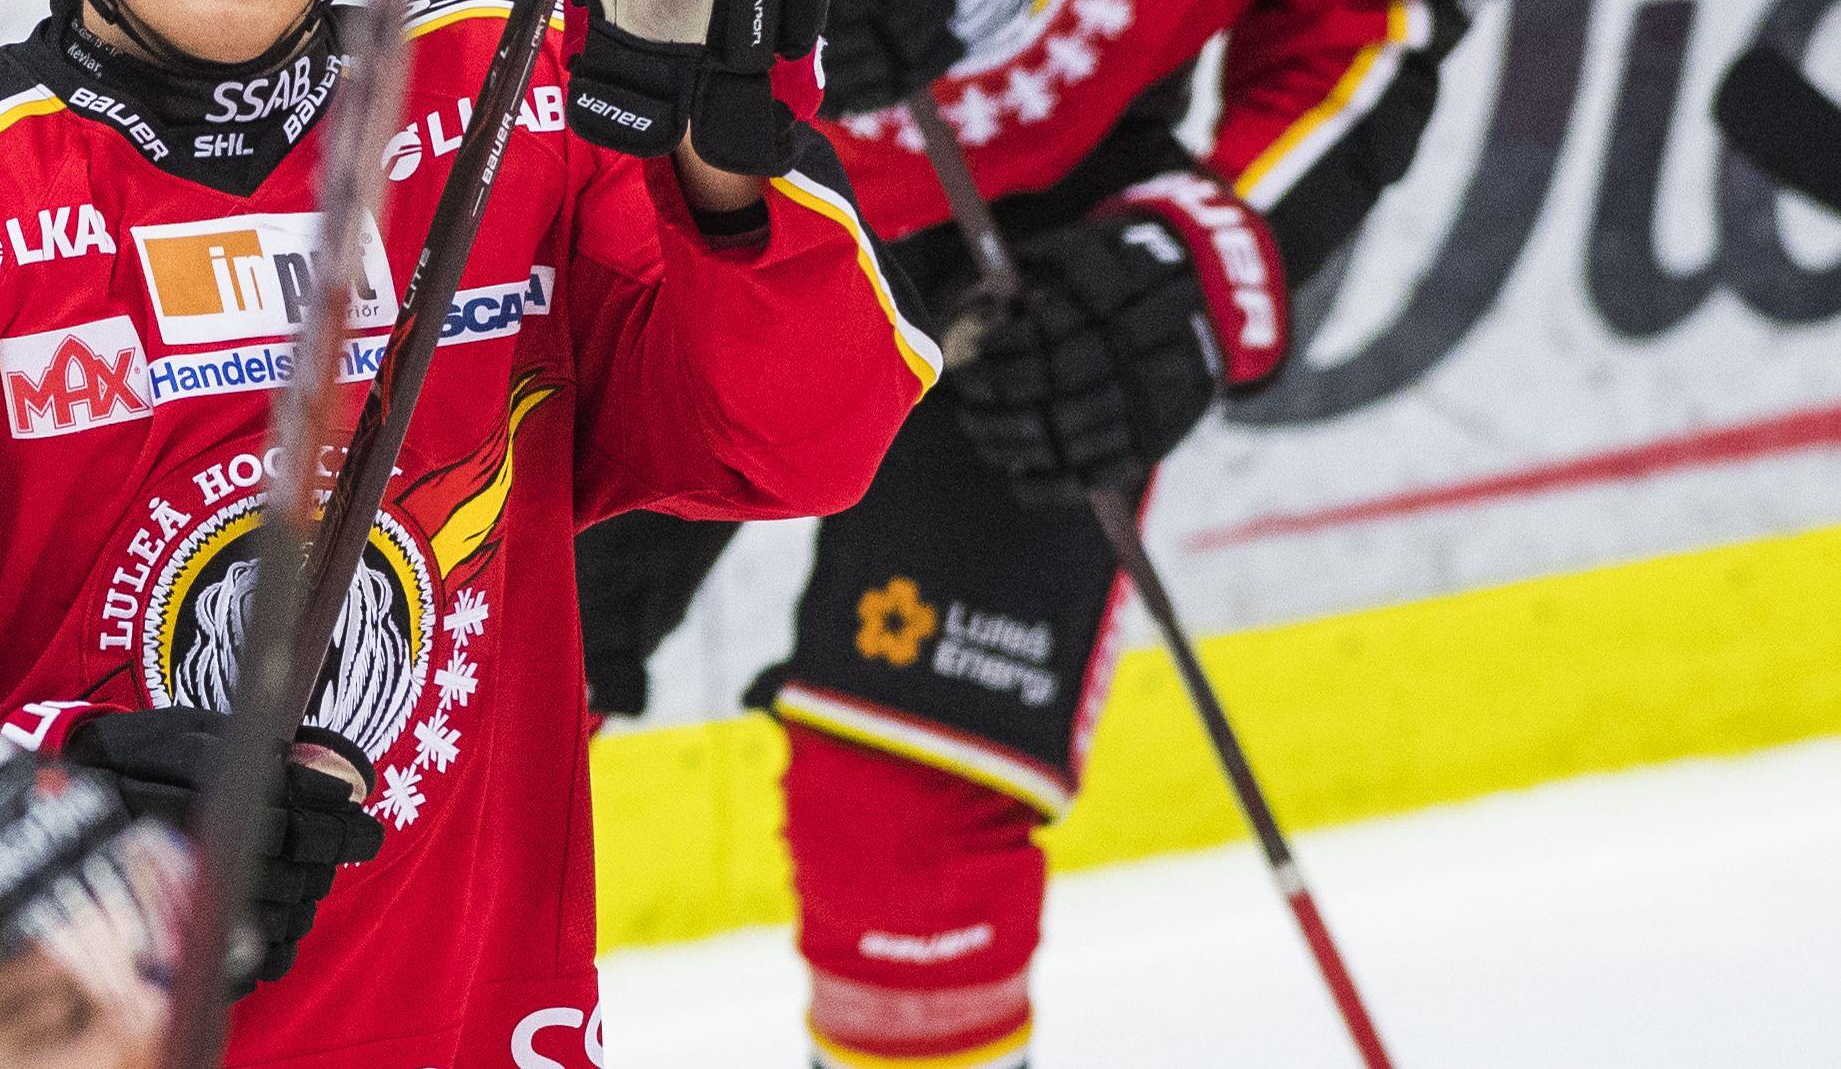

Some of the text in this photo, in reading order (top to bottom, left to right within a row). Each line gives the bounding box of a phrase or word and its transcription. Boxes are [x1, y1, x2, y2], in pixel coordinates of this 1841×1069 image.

[68, 86, 170, 163] BAUER
[205, 56, 312, 124] SSAB
[193, 133, 255, 159] SHL
[6, 333, 152, 435] MAX
[99, 497, 192, 652] LULEÅ
